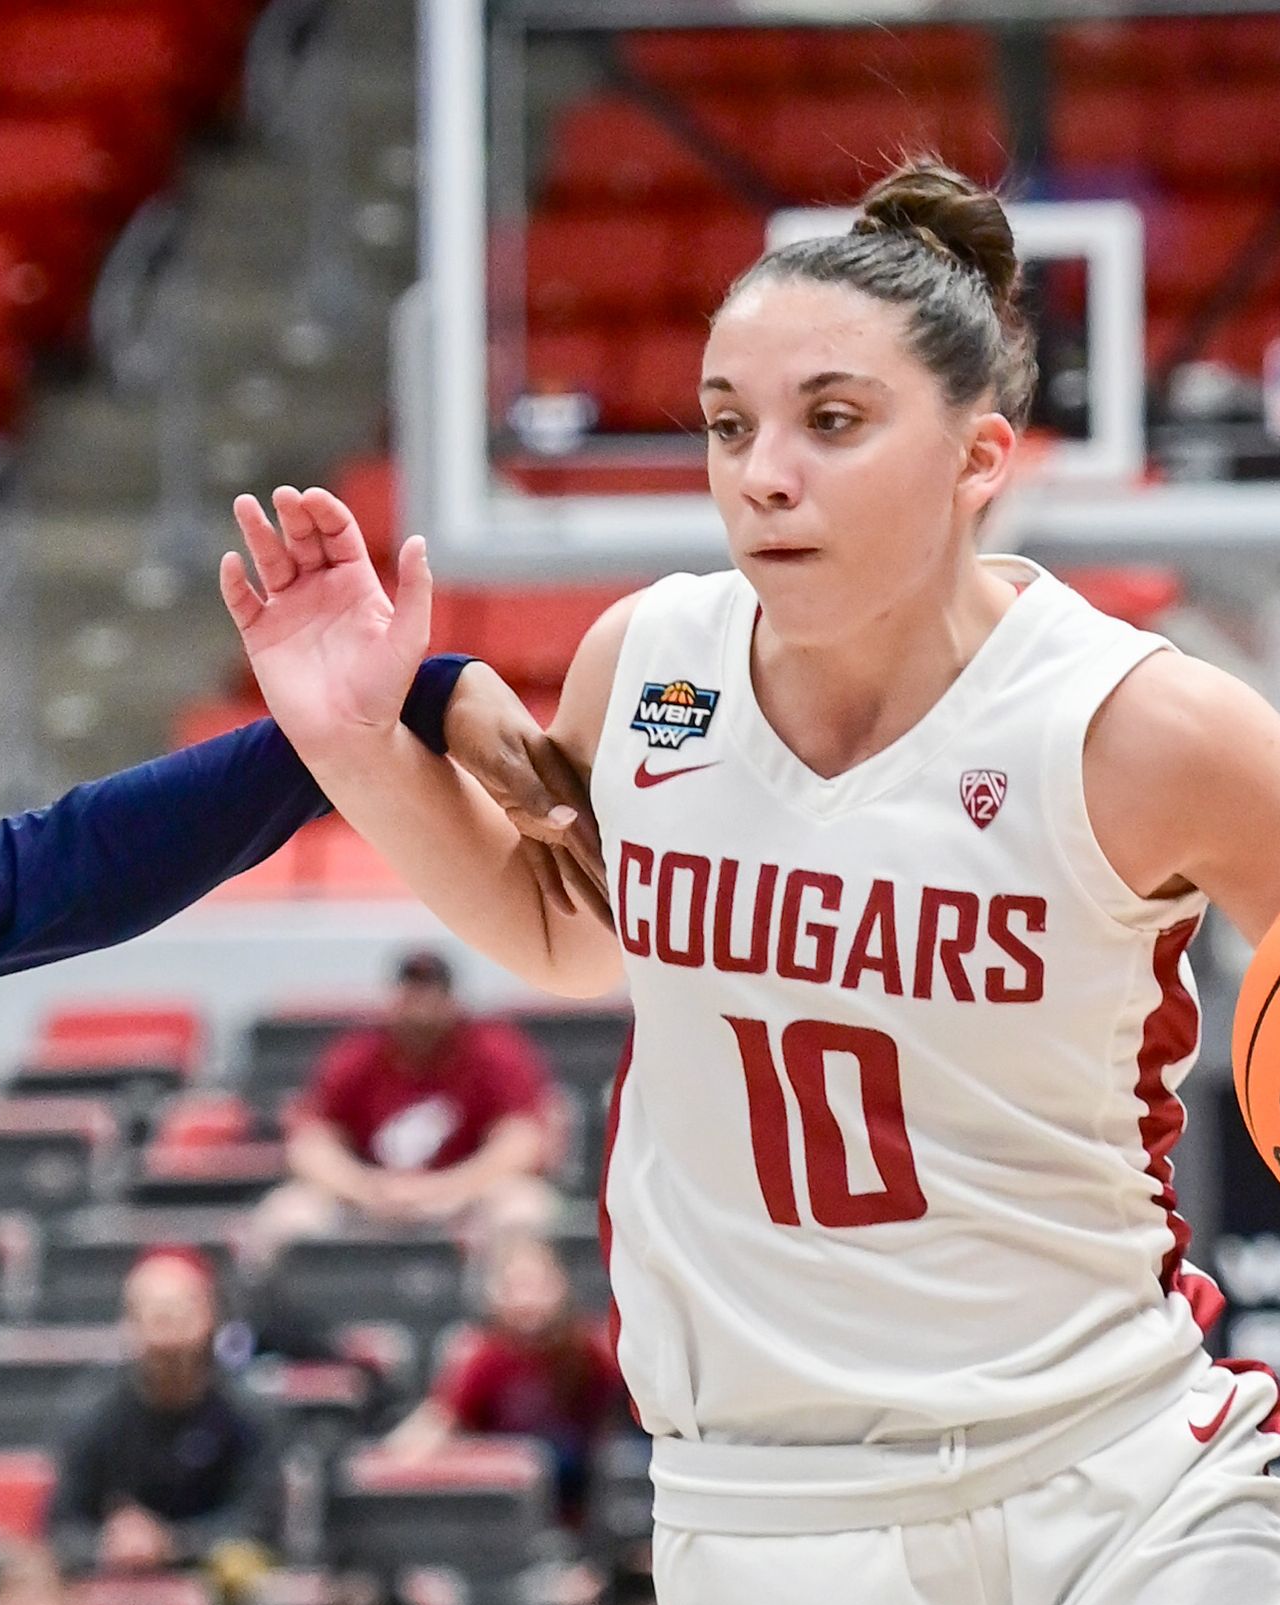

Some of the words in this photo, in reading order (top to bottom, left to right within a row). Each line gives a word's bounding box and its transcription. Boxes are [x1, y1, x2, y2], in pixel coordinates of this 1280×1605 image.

[640, 700, 711, 727] WBIT
[962, 770, 1007, 806] PAC
[970, 795, 995, 820] 12
[619, 839, 1047, 1005] COUGARS
[721, 1014, 929, 1228] 10
